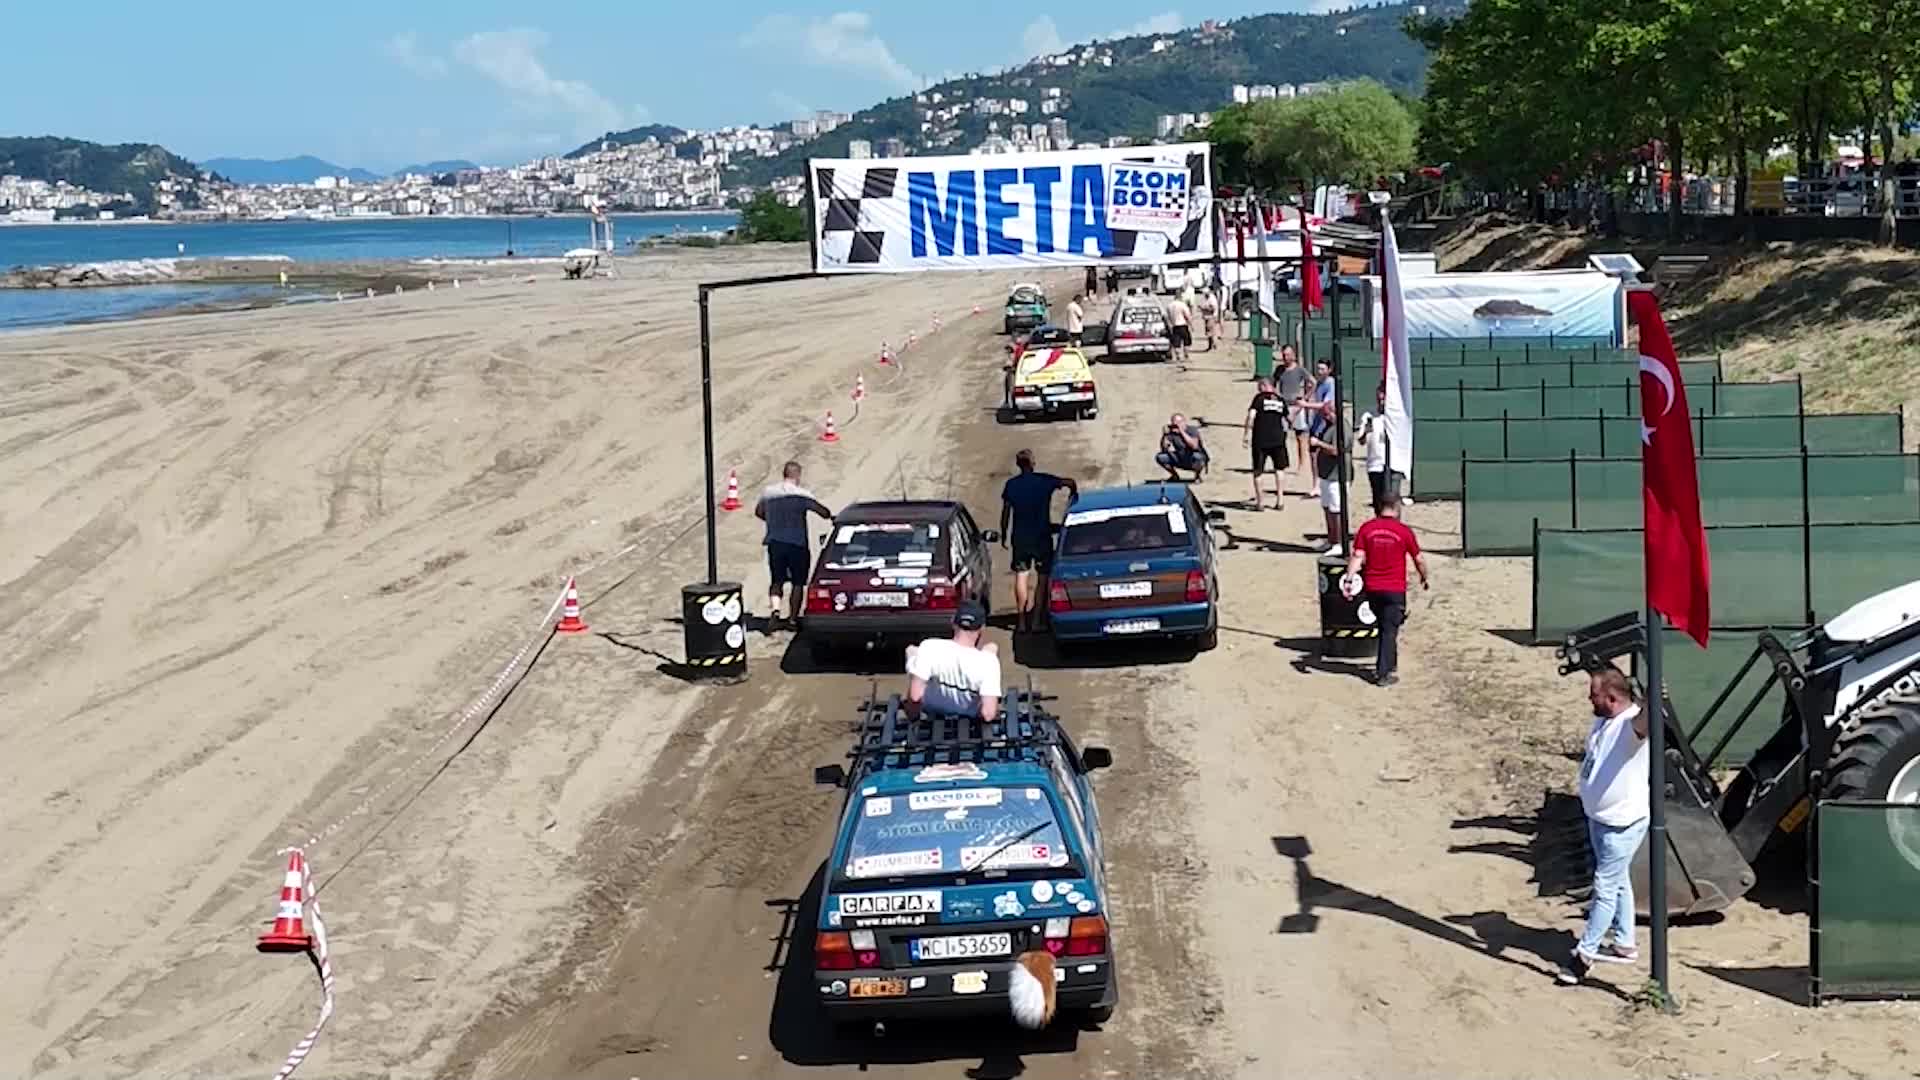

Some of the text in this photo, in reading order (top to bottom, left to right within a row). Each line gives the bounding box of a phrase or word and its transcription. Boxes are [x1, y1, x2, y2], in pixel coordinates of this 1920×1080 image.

[1113, 169, 1185, 190] ZŁOM
[1113, 188, 1162, 208] BOL
[908, 164, 1114, 258] META
[856, 914, 926, 927] www.carfax.pl
[920, 935, 1009, 957] WCI 53659
